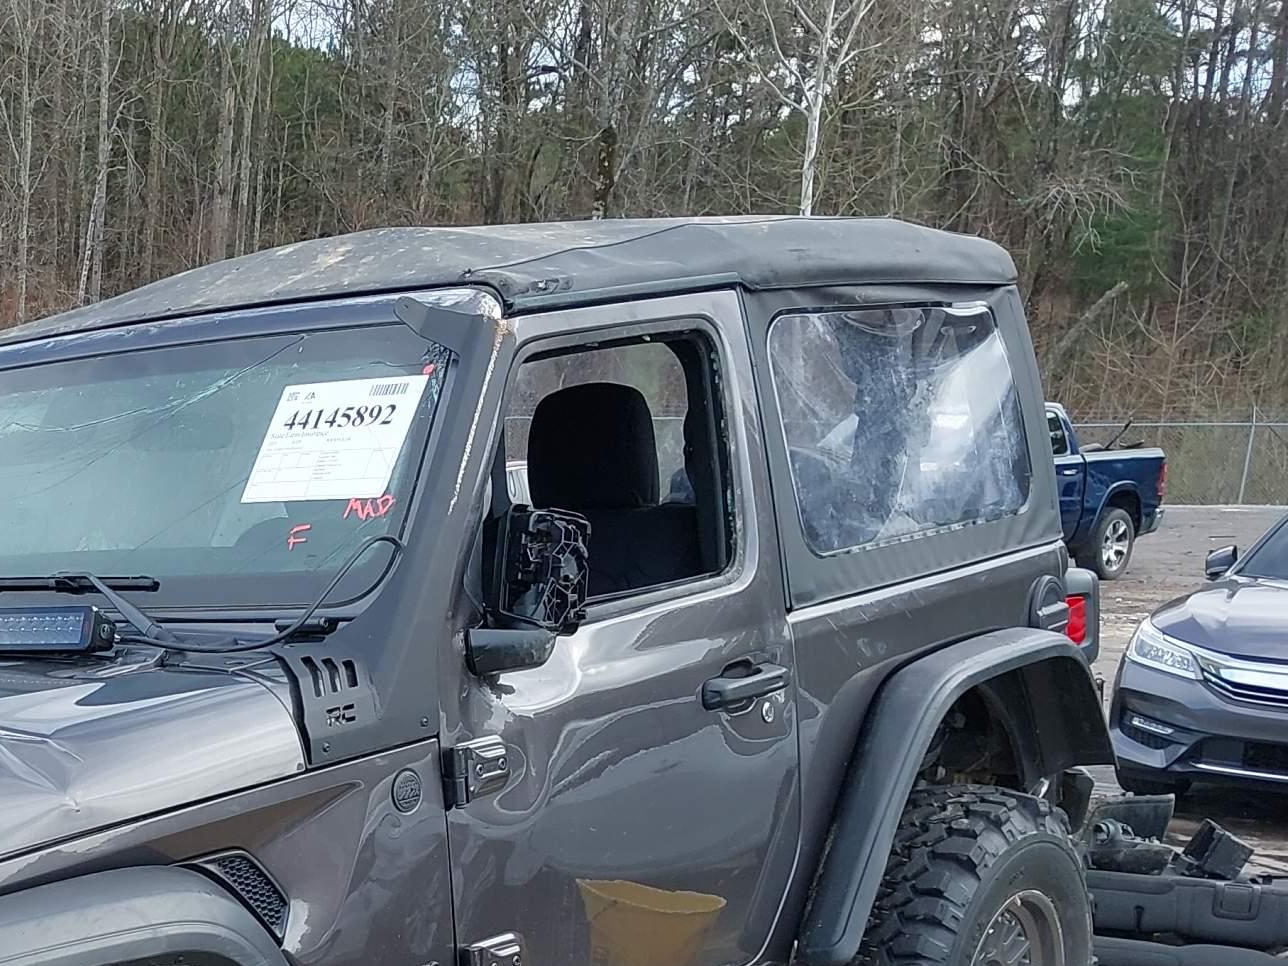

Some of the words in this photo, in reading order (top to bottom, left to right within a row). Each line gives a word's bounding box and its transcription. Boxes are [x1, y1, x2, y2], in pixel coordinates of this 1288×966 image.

[284, 404, 397, 431] 44145892
[287, 523, 312, 551] F
[326, 703, 356, 728] RC
